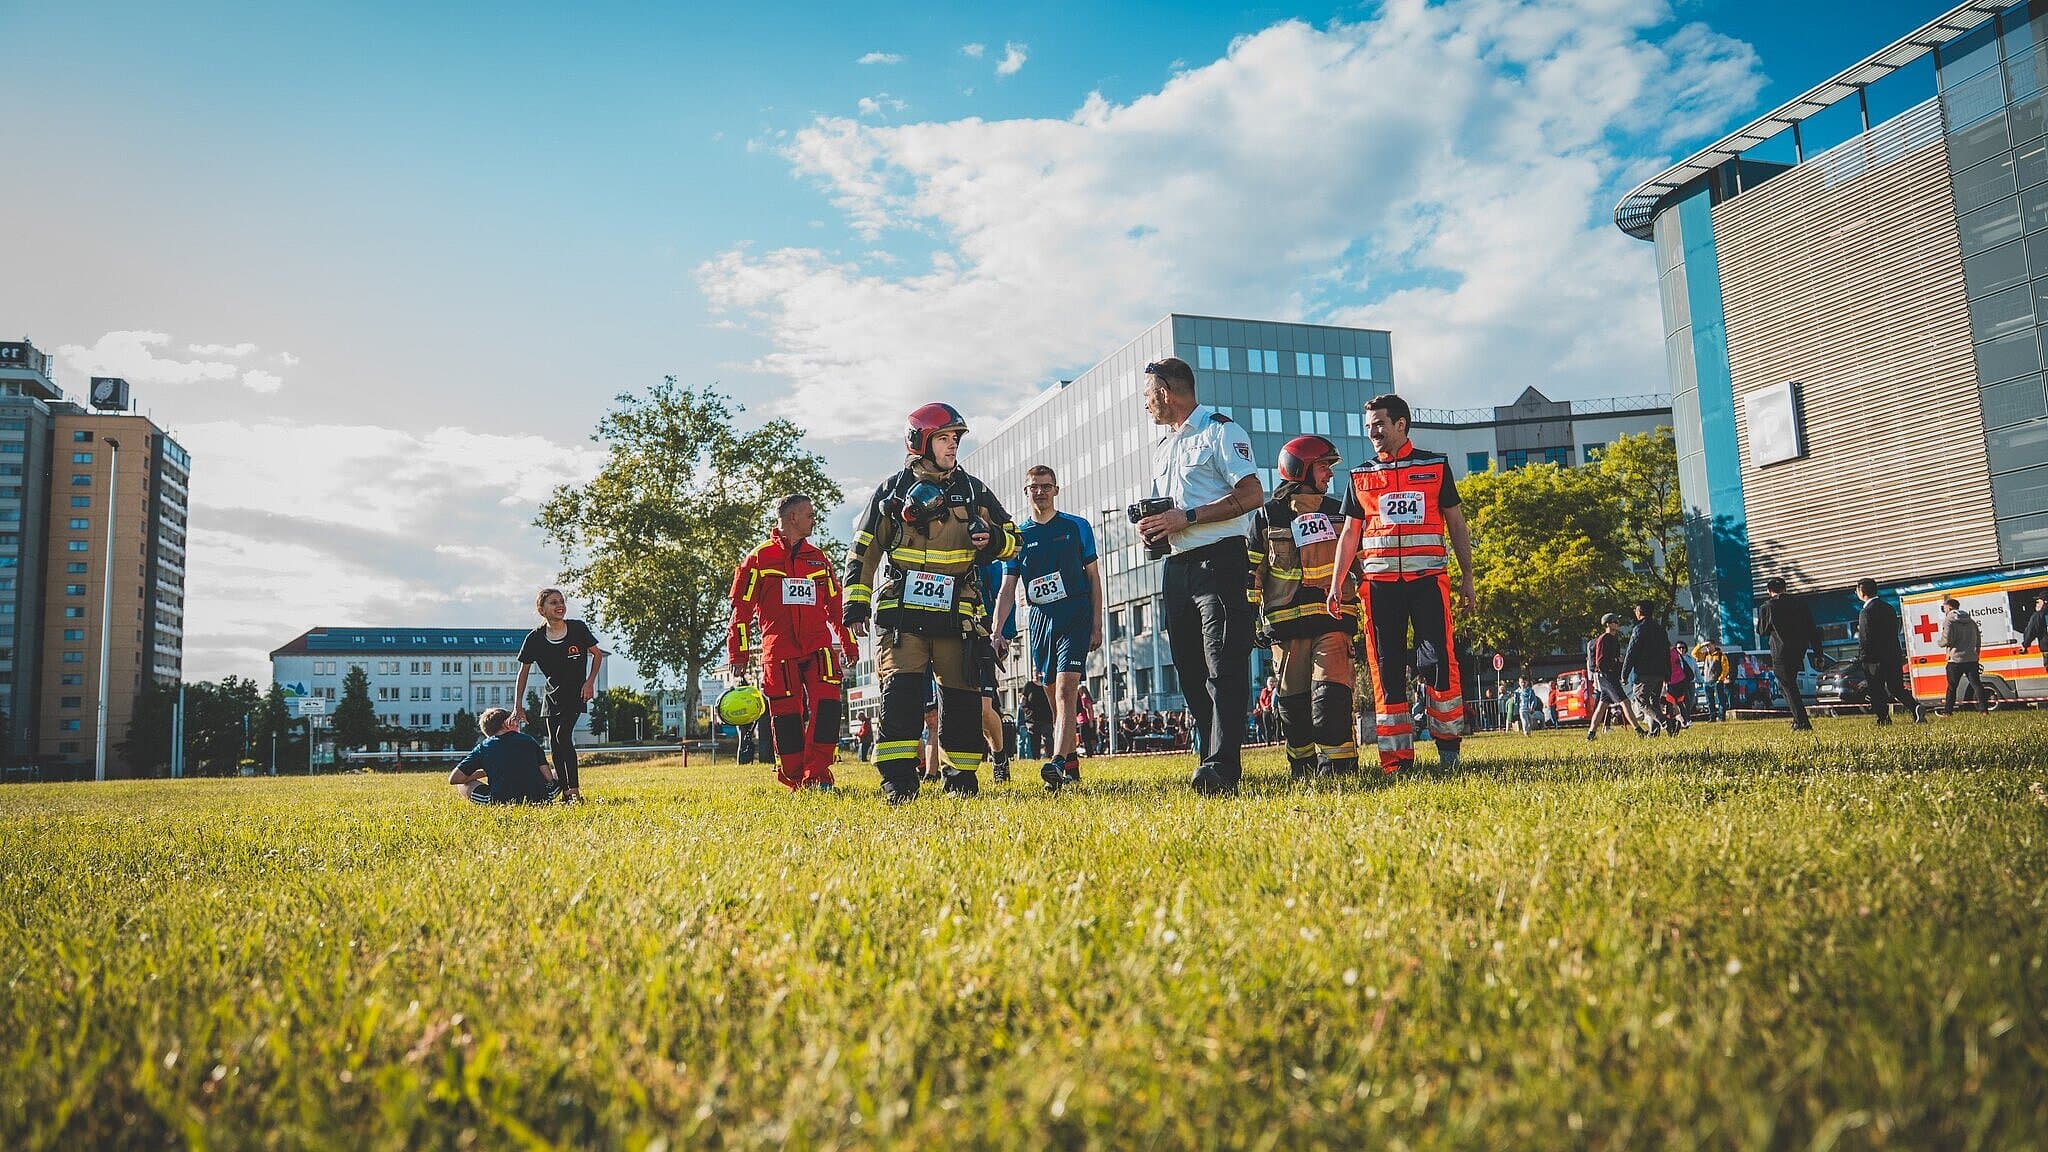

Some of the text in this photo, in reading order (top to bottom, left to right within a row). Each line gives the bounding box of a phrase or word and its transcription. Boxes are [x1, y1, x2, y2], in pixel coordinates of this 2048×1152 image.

[1387, 500, 1418, 516] 284
[1299, 520, 1328, 537] 284
[789, 585, 812, 598] 284
[912, 580, 945, 599] 284
[1033, 581, 1058, 599] 283
[1968, 606, 2004, 617] tsches
